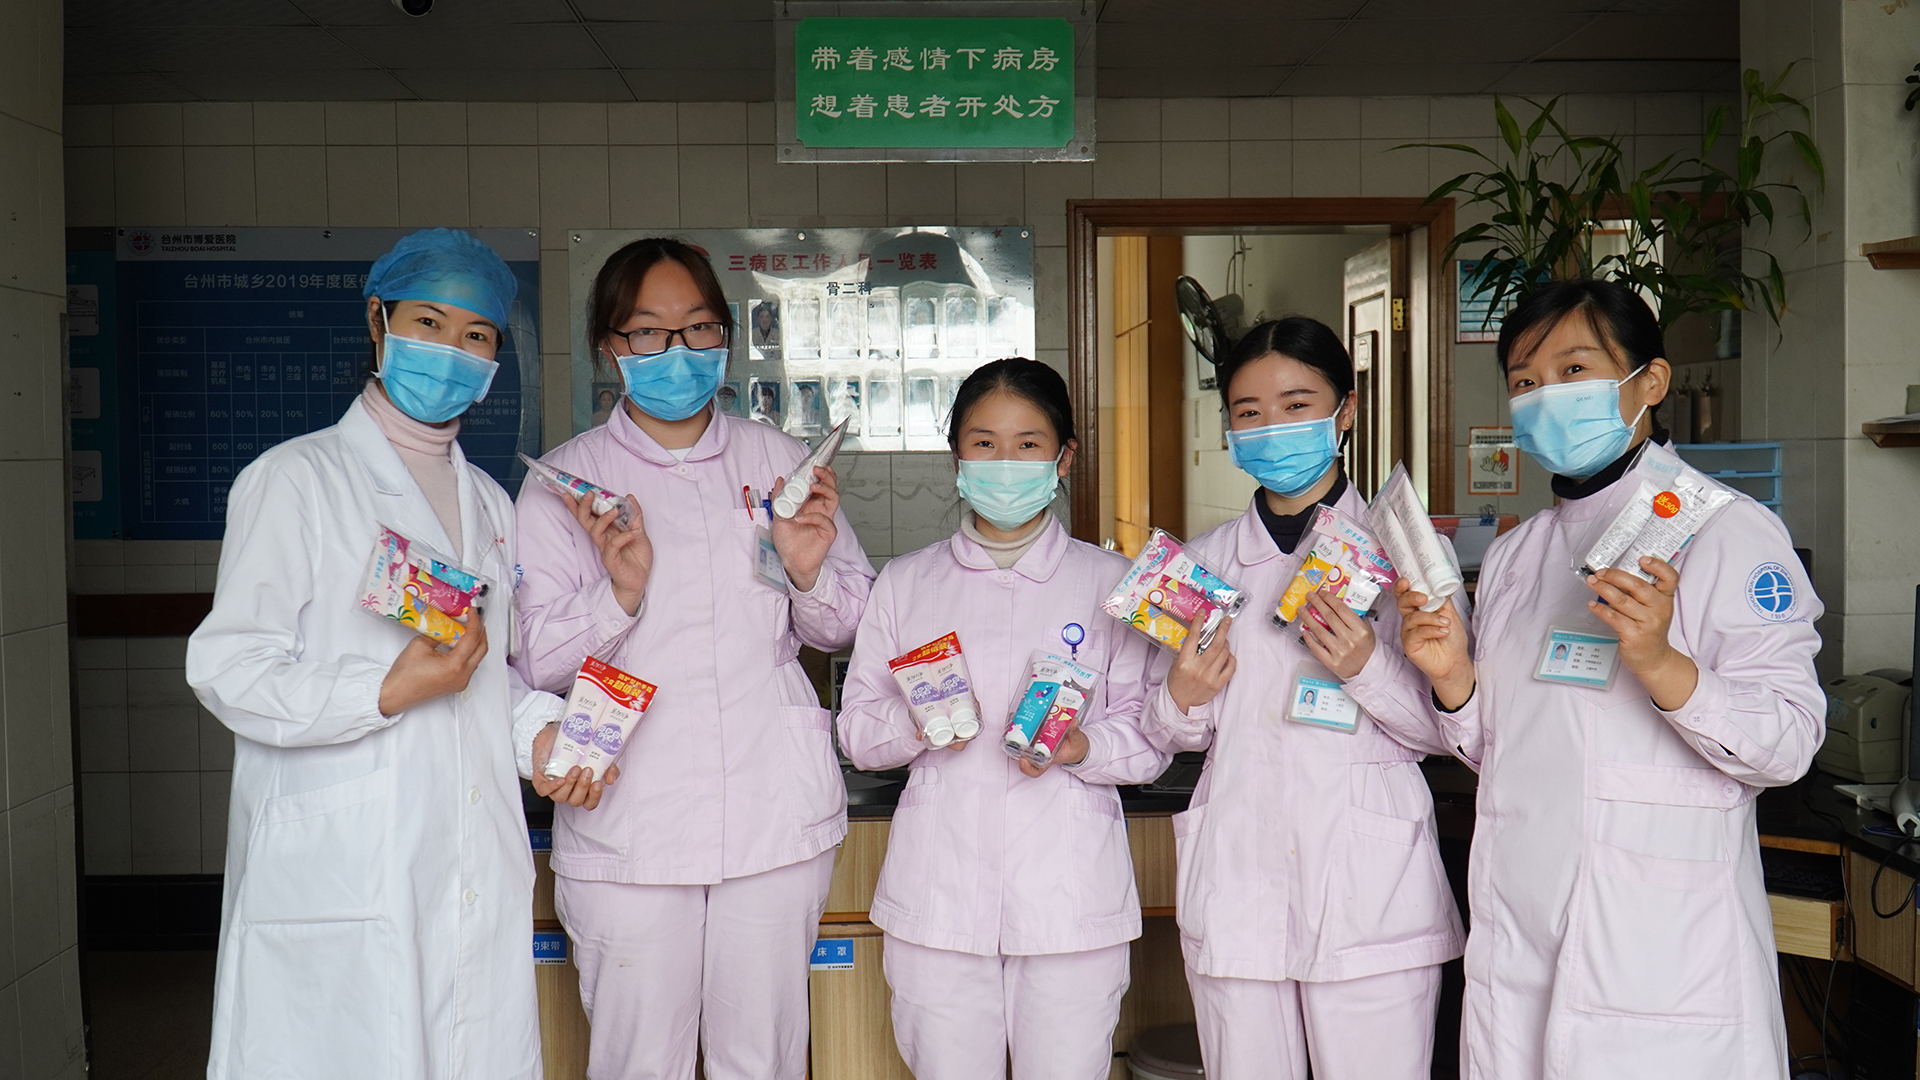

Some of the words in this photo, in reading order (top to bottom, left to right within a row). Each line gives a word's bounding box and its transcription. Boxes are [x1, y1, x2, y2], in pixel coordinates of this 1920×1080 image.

[811, 46, 1060, 71] 带着感情下病房
[810, 94, 1060, 119] 想着患者开处方
[161, 234, 236, 245] 台州市博爱医院
[827, 281, 872, 296] 骨二科
[260, 410, 279, 418] 20%
[286, 410, 304, 418] 10%
